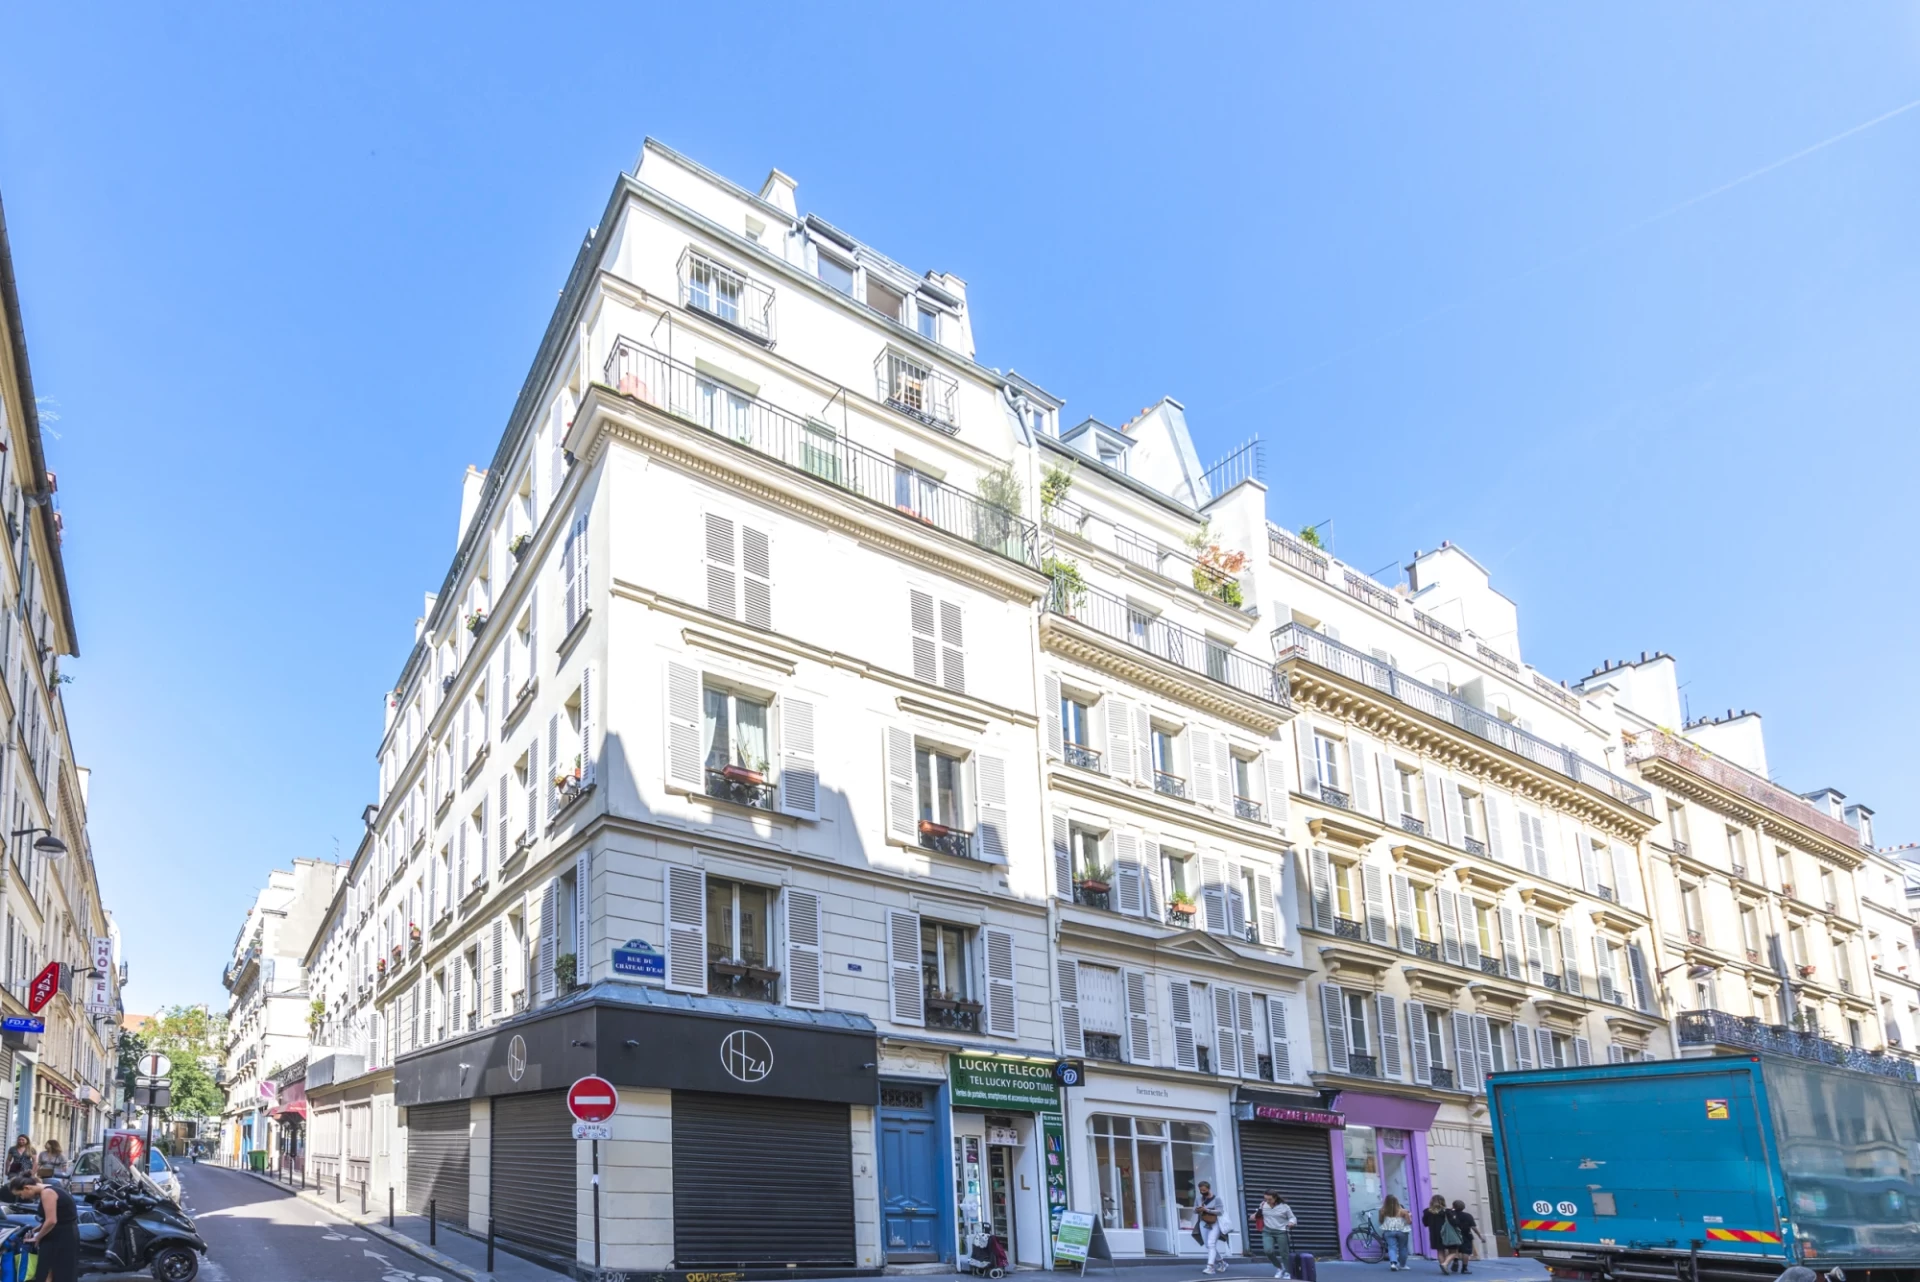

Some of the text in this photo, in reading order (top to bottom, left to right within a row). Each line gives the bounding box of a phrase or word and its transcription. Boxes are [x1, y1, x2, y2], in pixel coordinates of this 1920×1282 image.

[615, 963, 644, 971] CHÂTEAU
[34, 972, 54, 1003] TABAC
[86, 1005, 114, 1014] LITTLE
[959, 1059, 998, 1073] LUCKY
[970, 1075, 1054, 1093] TEL LUCKY FOOD TIME
[1536, 1203, 1550, 1213] 80
[1560, 1203, 1574, 1214] 90
